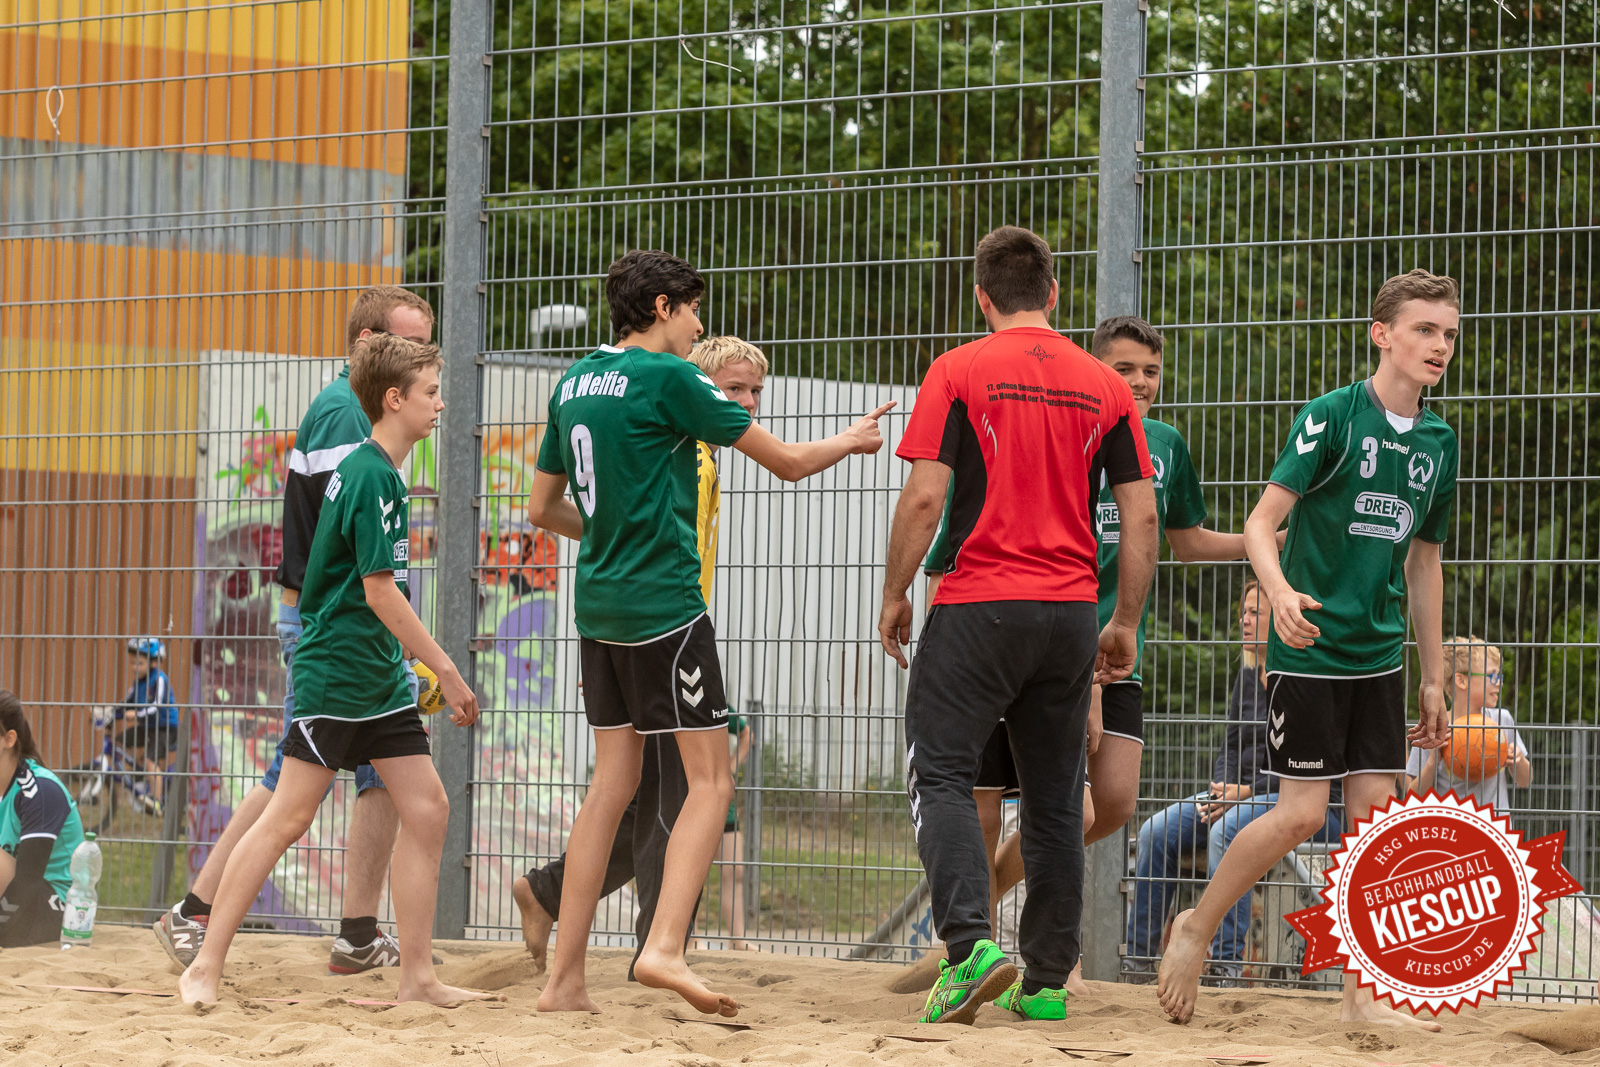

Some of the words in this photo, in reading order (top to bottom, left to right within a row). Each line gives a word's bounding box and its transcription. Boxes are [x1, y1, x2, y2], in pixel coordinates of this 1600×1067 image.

[575, 370, 629, 398] Welfia
[570, 424, 596, 517] 9
[1359, 436, 1379, 479] 3
[1288, 757, 1324, 769] hummel
[173, 932, 194, 949] N
